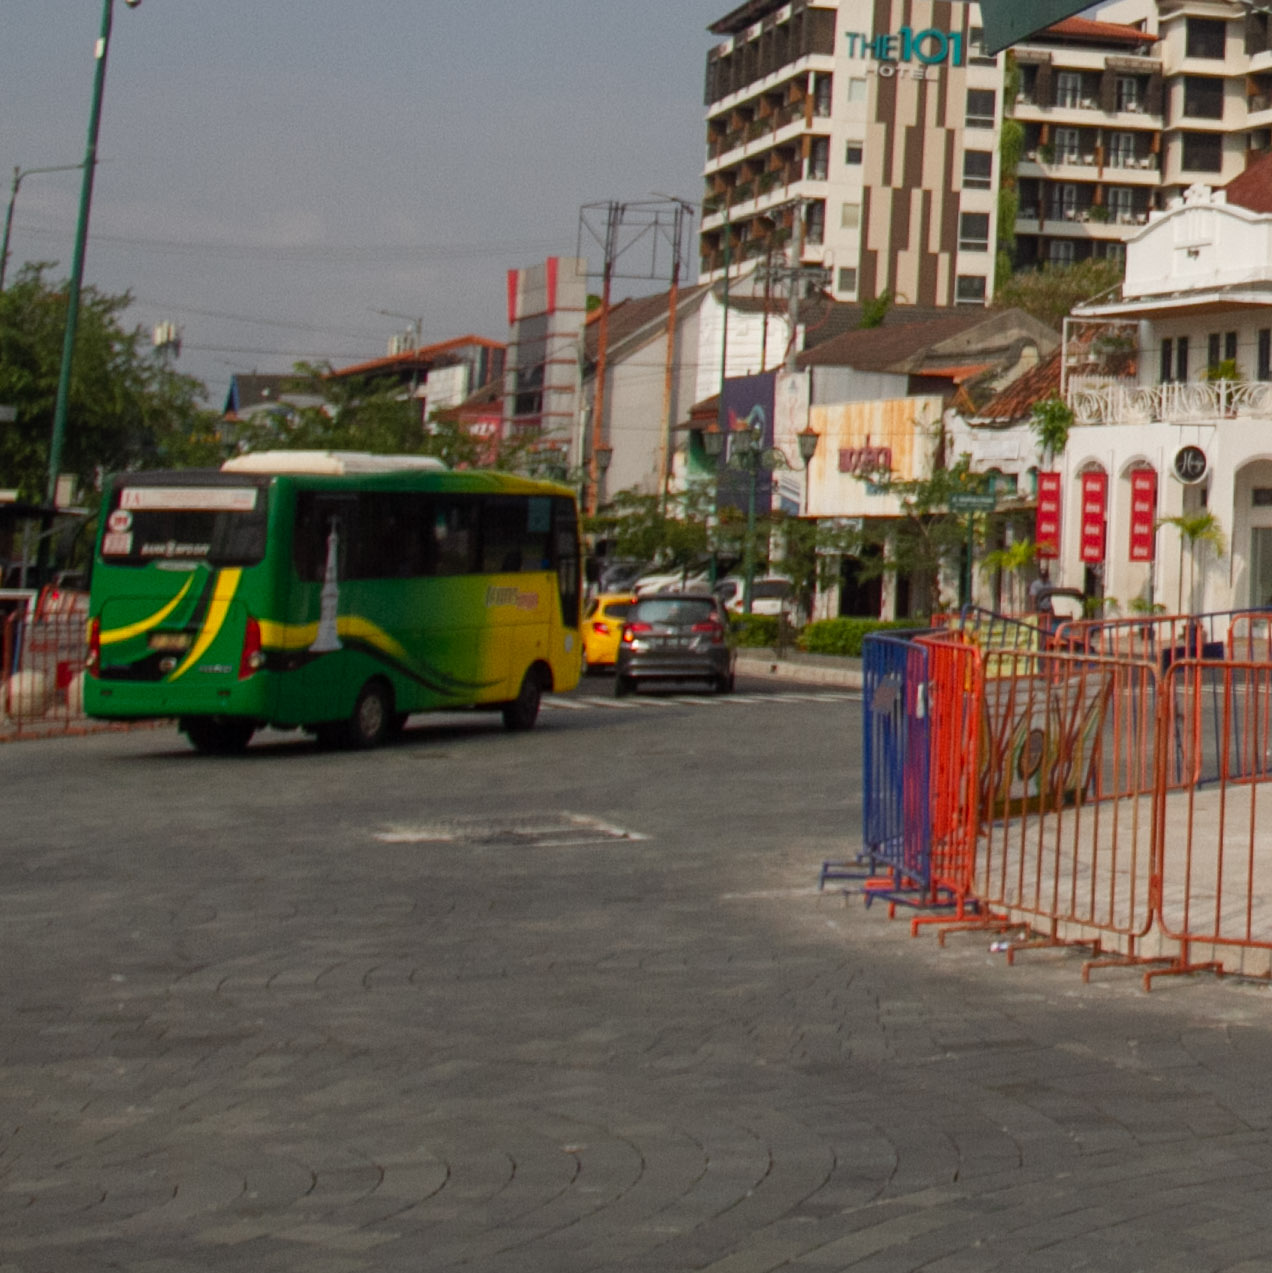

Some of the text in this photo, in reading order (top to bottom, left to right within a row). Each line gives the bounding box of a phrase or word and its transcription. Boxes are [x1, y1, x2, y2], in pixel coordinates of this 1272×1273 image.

[845, 26, 961, 67] THE 101
[868, 65, 940, 82] HOTEL
